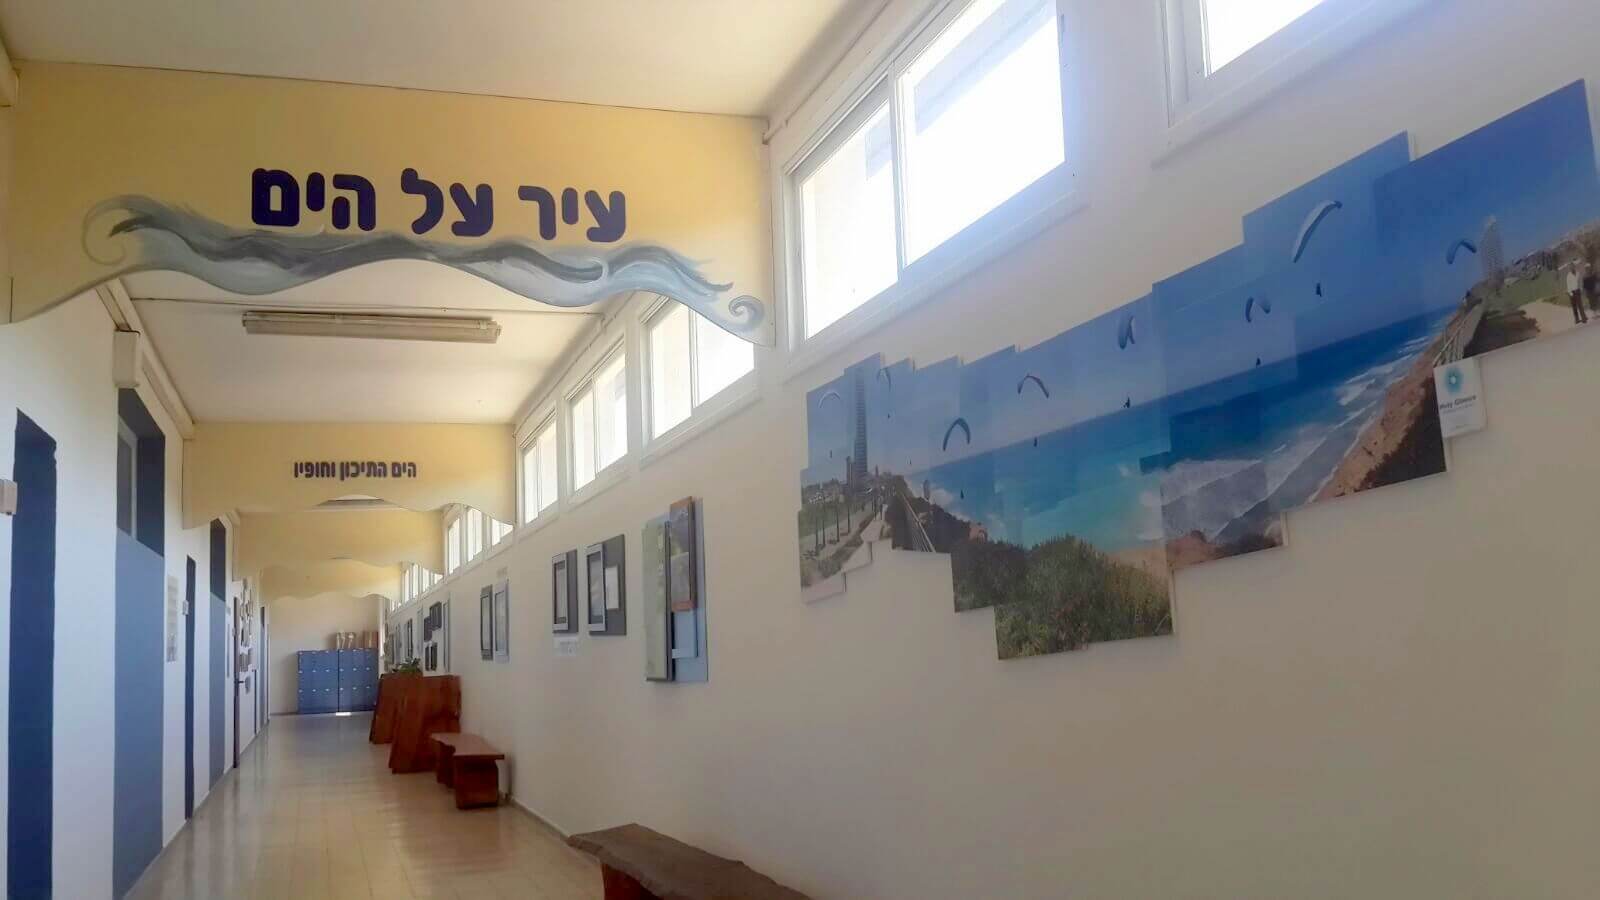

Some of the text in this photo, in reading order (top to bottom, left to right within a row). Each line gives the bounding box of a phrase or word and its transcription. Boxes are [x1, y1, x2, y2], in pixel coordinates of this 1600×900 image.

[251, 168, 626, 242] עיר על הים
[294, 461, 417, 481] הים התיכון וחופיו
